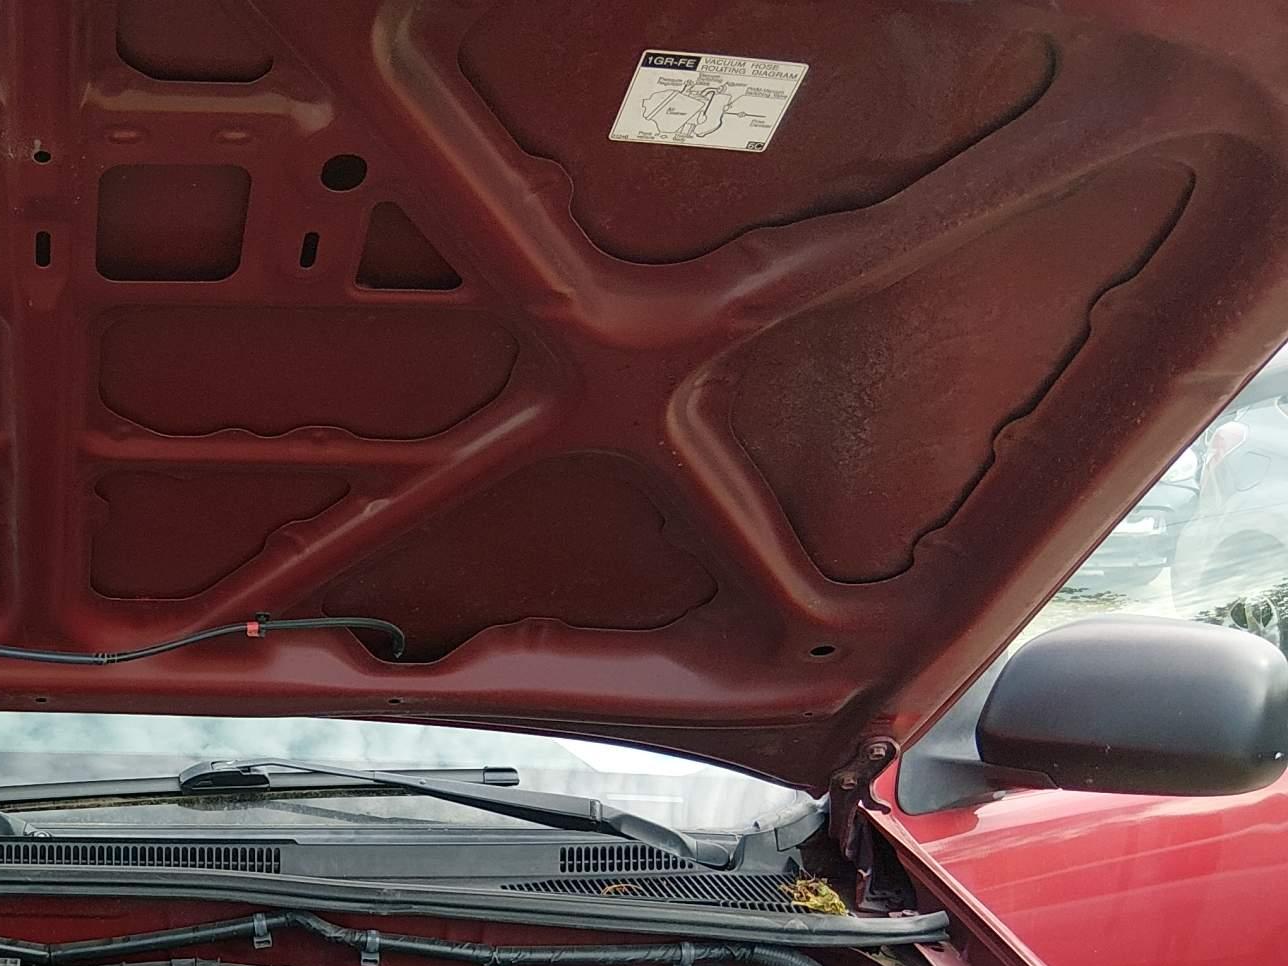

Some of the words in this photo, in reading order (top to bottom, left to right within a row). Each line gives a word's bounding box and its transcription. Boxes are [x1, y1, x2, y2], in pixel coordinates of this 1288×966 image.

[648, 56, 697, 68] 1GR-FE
[704, 57, 746, 67] VACUUM
[750, 62, 780, 70] HOSE
[700, 65, 746, 75] ROUTING
[751, 69, 798, 80] DIAGRAM
